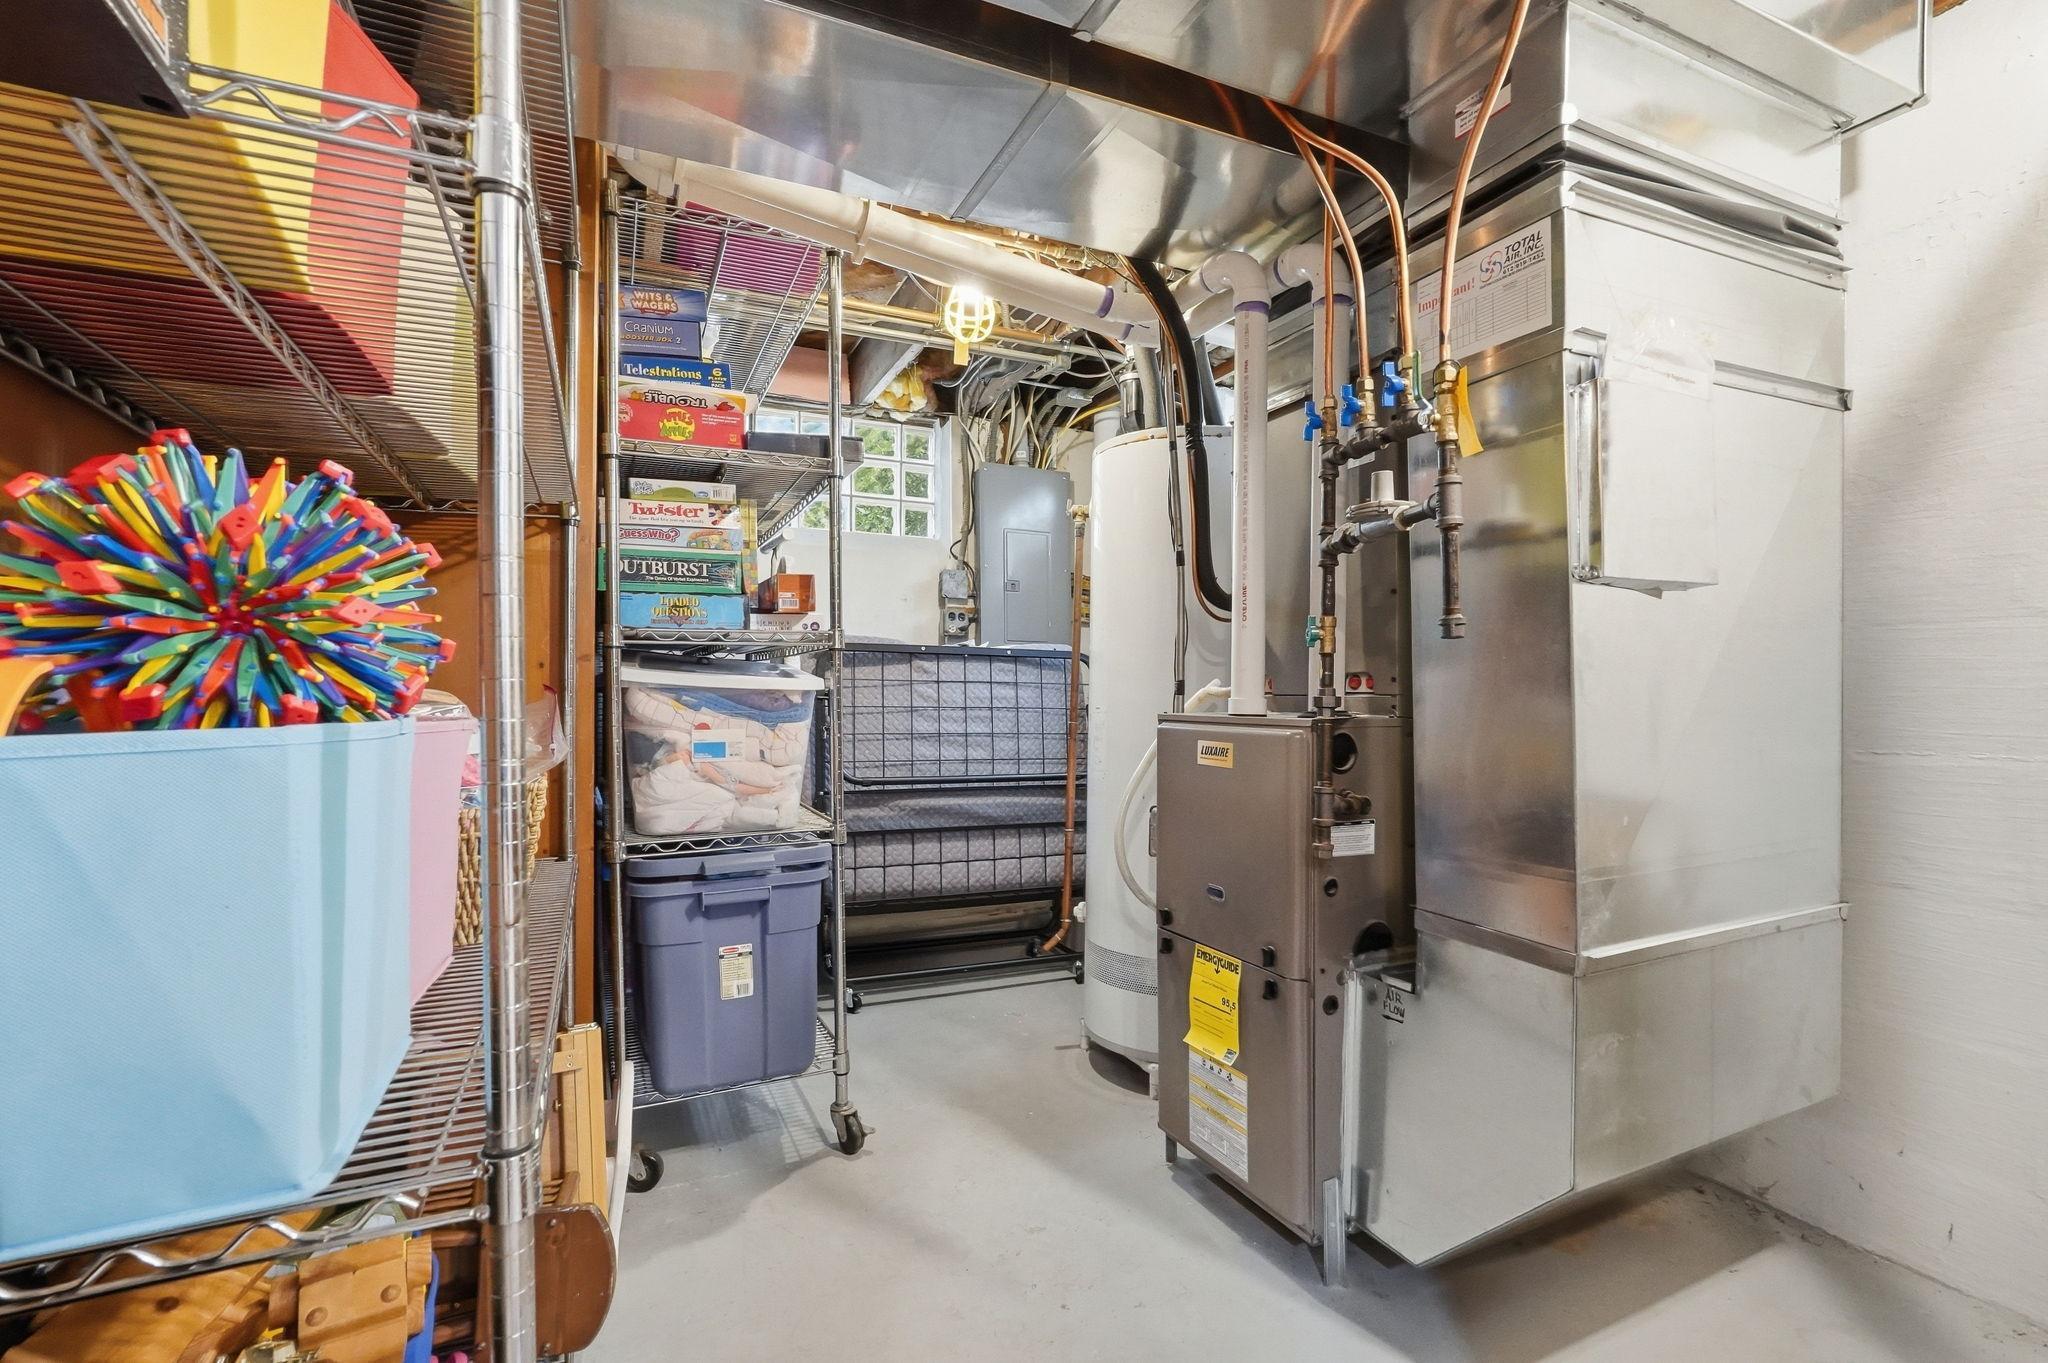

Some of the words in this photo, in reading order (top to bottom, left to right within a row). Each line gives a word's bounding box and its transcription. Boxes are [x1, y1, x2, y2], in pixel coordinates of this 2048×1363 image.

[1505, 231, 1543, 255] TOTAL
[1524, 240, 1544, 255] INC.
[633, 290, 661, 301] WITS
[631, 299, 677, 313] WAGERS
[676, 336, 681, 344] 2
[623, 363, 702, 380] Telestrations
[712, 367, 722, 377] 6
[644, 391, 708, 408] TROUBLE
[628, 502, 704, 518] Twister
[661, 596, 700, 607] LOADED
[652, 606, 709, 618] QUESTIONS
[1200, 745, 1230, 757] LUXAIRE
[1386, 988, 1403, 1005] AIR
[1383, 1000, 1405, 1018] FLOW
